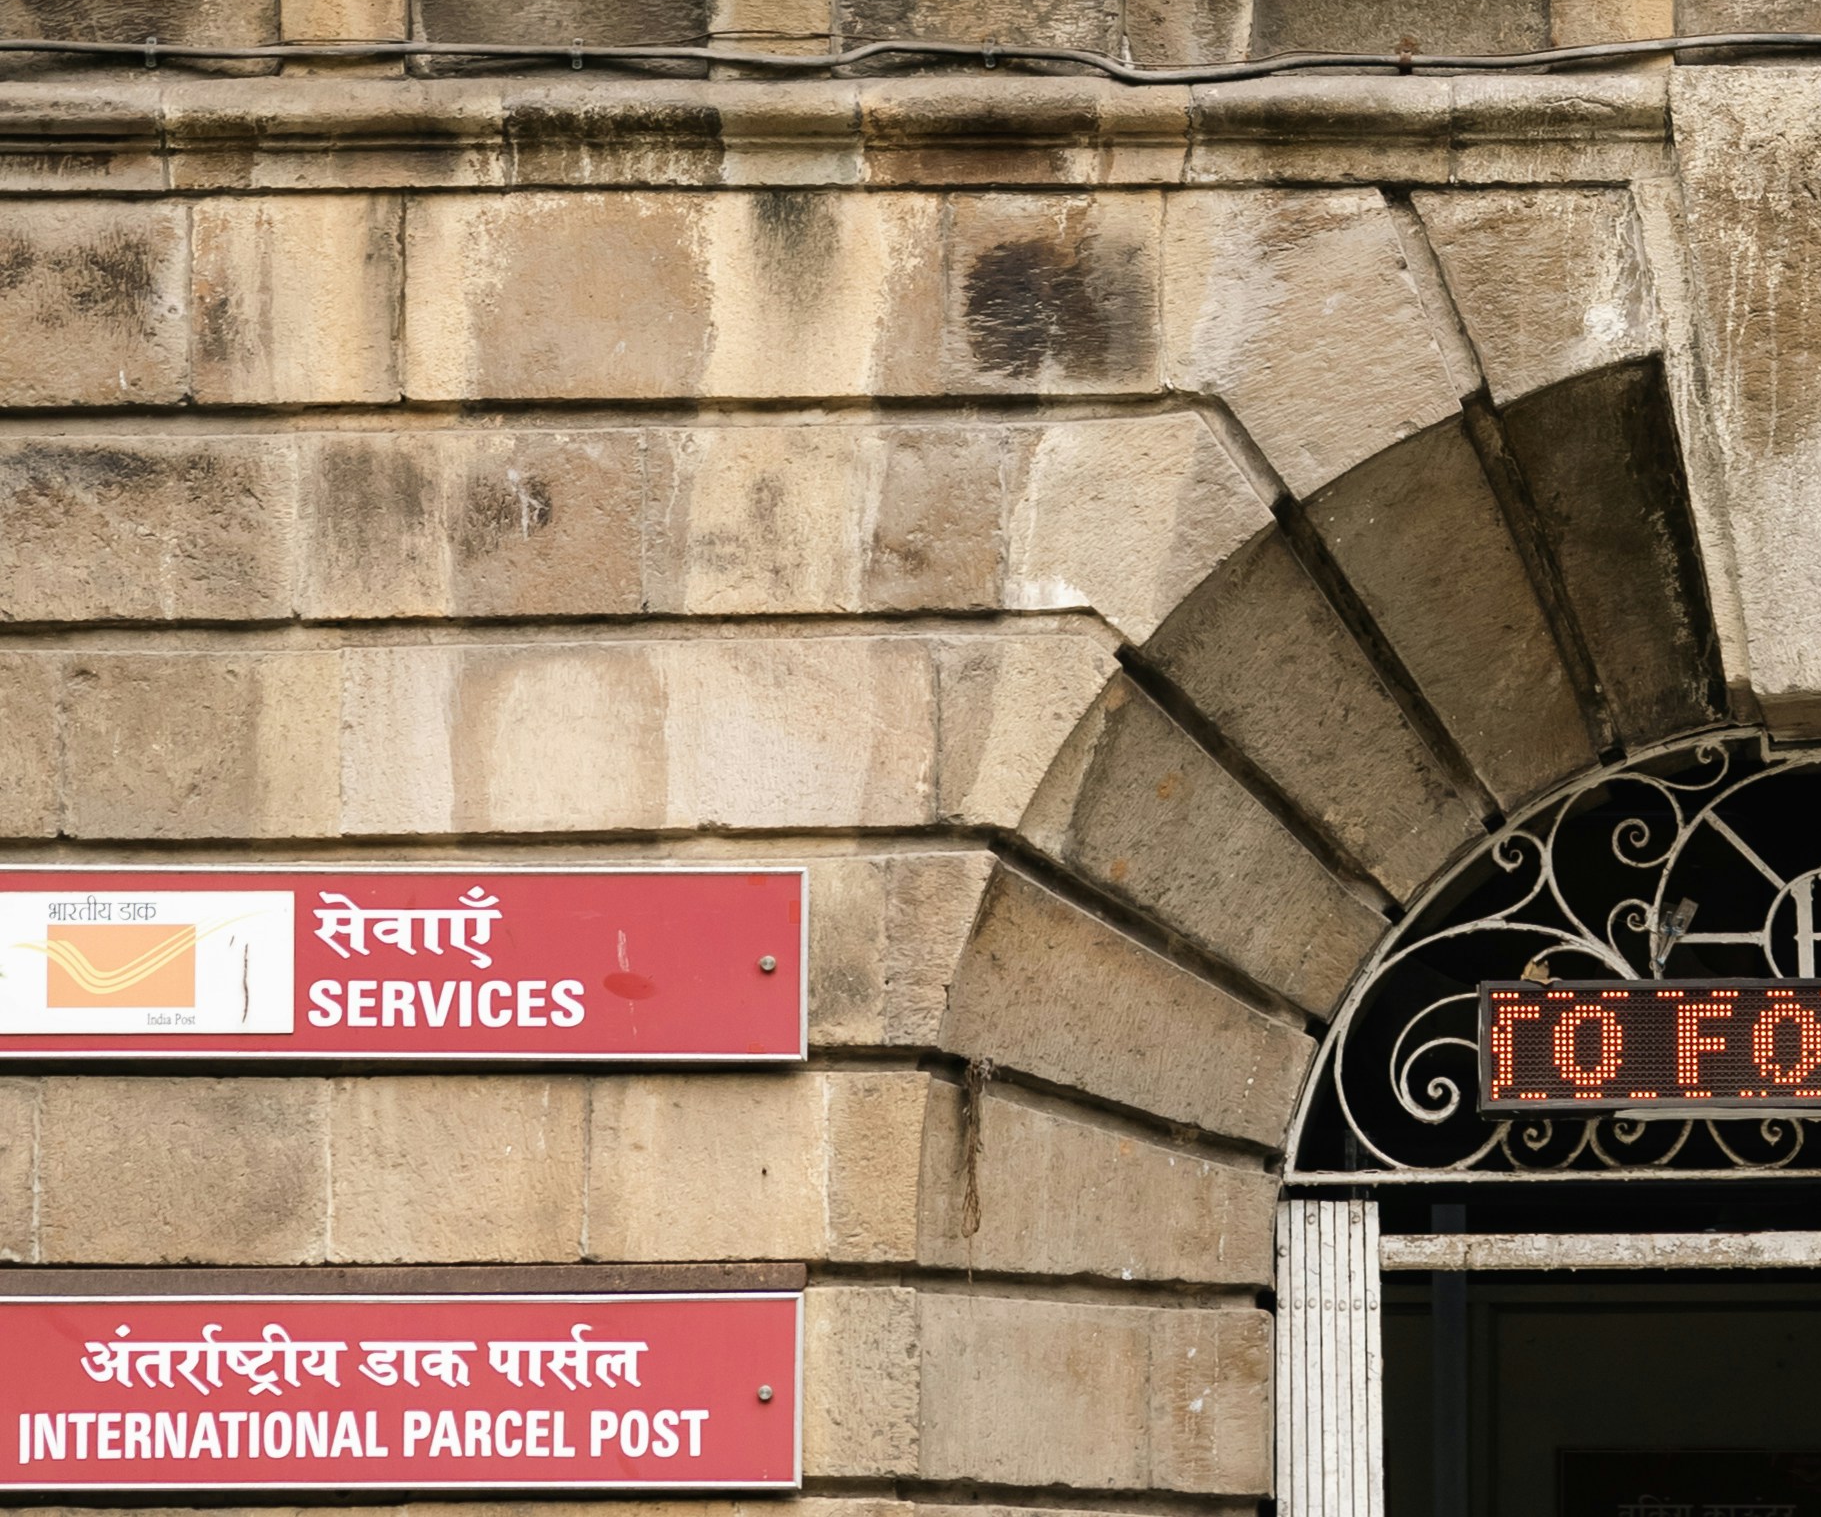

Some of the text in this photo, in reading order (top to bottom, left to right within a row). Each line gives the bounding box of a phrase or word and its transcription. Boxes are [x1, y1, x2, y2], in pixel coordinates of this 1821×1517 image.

[48, 895, 156, 921] भारतीय डाक
[313, 886, 502, 968] सेवाएँ
[147, 1013, 196, 1026] India Post
[308, 980, 584, 1027] SERVICES
[81, 1324, 648, 1395] अंतर्राष्ट्रीय डाक पार्सल
[20, 1410, 709, 1463] INTERNATIONAL PARCEL POST
